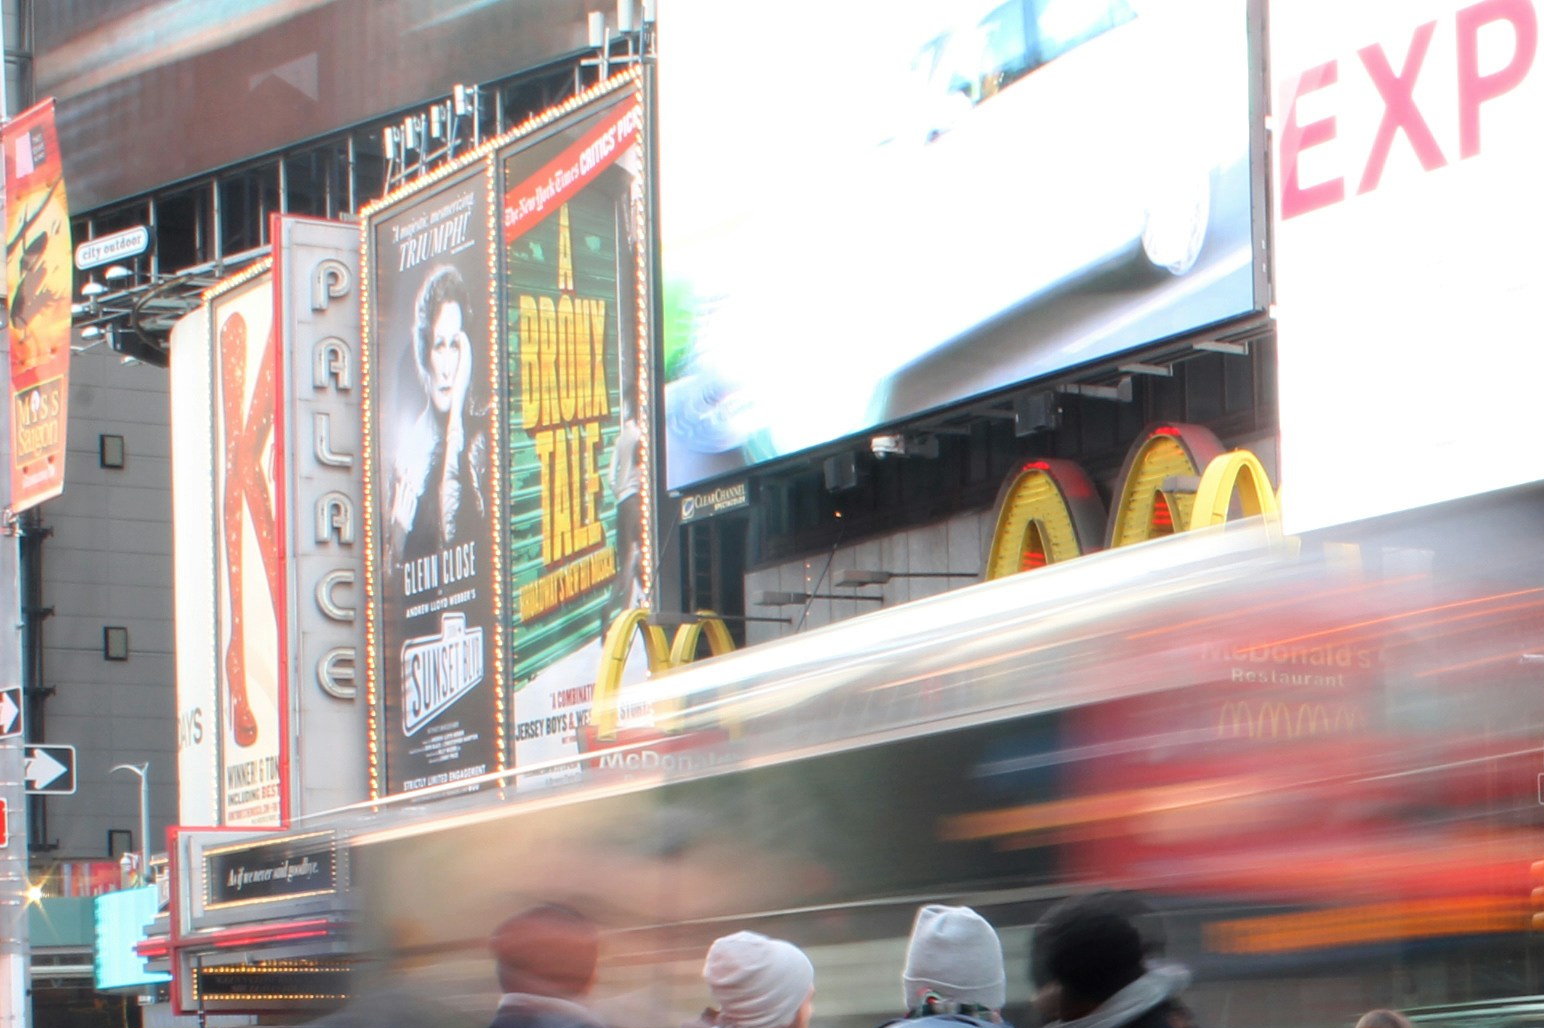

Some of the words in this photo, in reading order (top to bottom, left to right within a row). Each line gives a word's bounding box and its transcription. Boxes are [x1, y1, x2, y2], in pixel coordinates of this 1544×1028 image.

[558, 202, 574, 290] A
[520, 293, 609, 430] BRONX
[311, 258, 357, 699] PALACE
[535, 420, 602, 567] TALE
[404, 554, 438, 597] GLENN
[443, 541, 476, 585] CLOSE
[411, 643, 461, 718] SUNSET
[1231, 667, 1345, 688] Restaurant
[515, 719, 544, 741] JERSEY
[545, 714, 567, 735] BOYS
